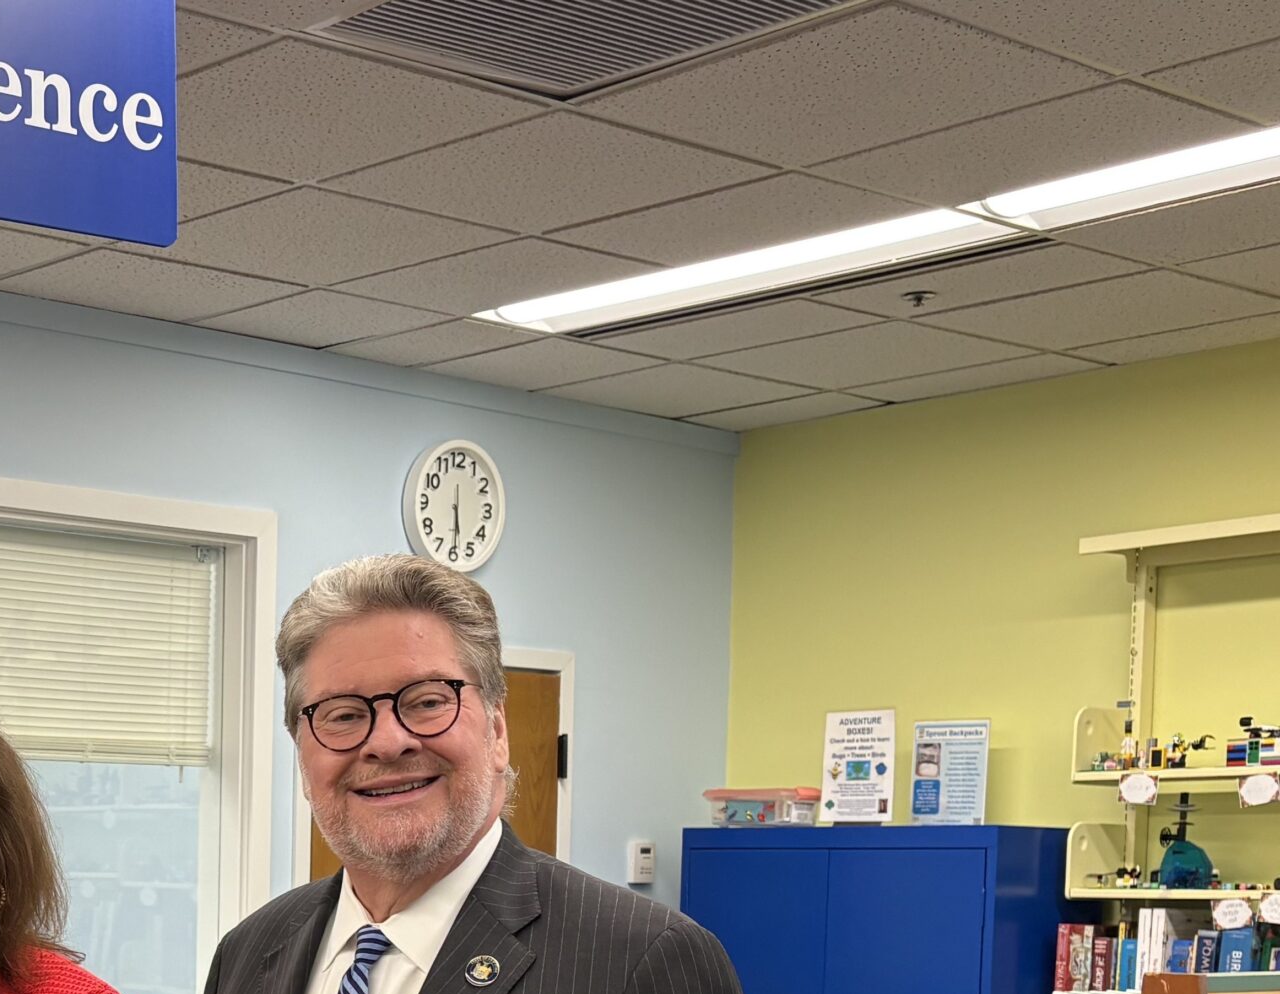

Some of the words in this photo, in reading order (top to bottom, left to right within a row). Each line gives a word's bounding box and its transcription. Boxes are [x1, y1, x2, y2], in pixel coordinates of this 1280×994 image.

[436, 456, 449, 474] 11
[450, 452, 466, 469] 12
[471, 461, 476, 476] 1
[426, 473, 440, 490] 10
[479, 478, 489, 494] 2
[483, 503, 493, 520] 3
[422, 517, 433, 535] 8
[476, 525, 486, 542] 4
[434, 537, 444, 553] 7
[448, 545, 458, 562] 6
[465, 542, 475, 557] 5
[839, 716, 882, 726] ADVENTURE
[1230, 950, 1243, 973] BIR
